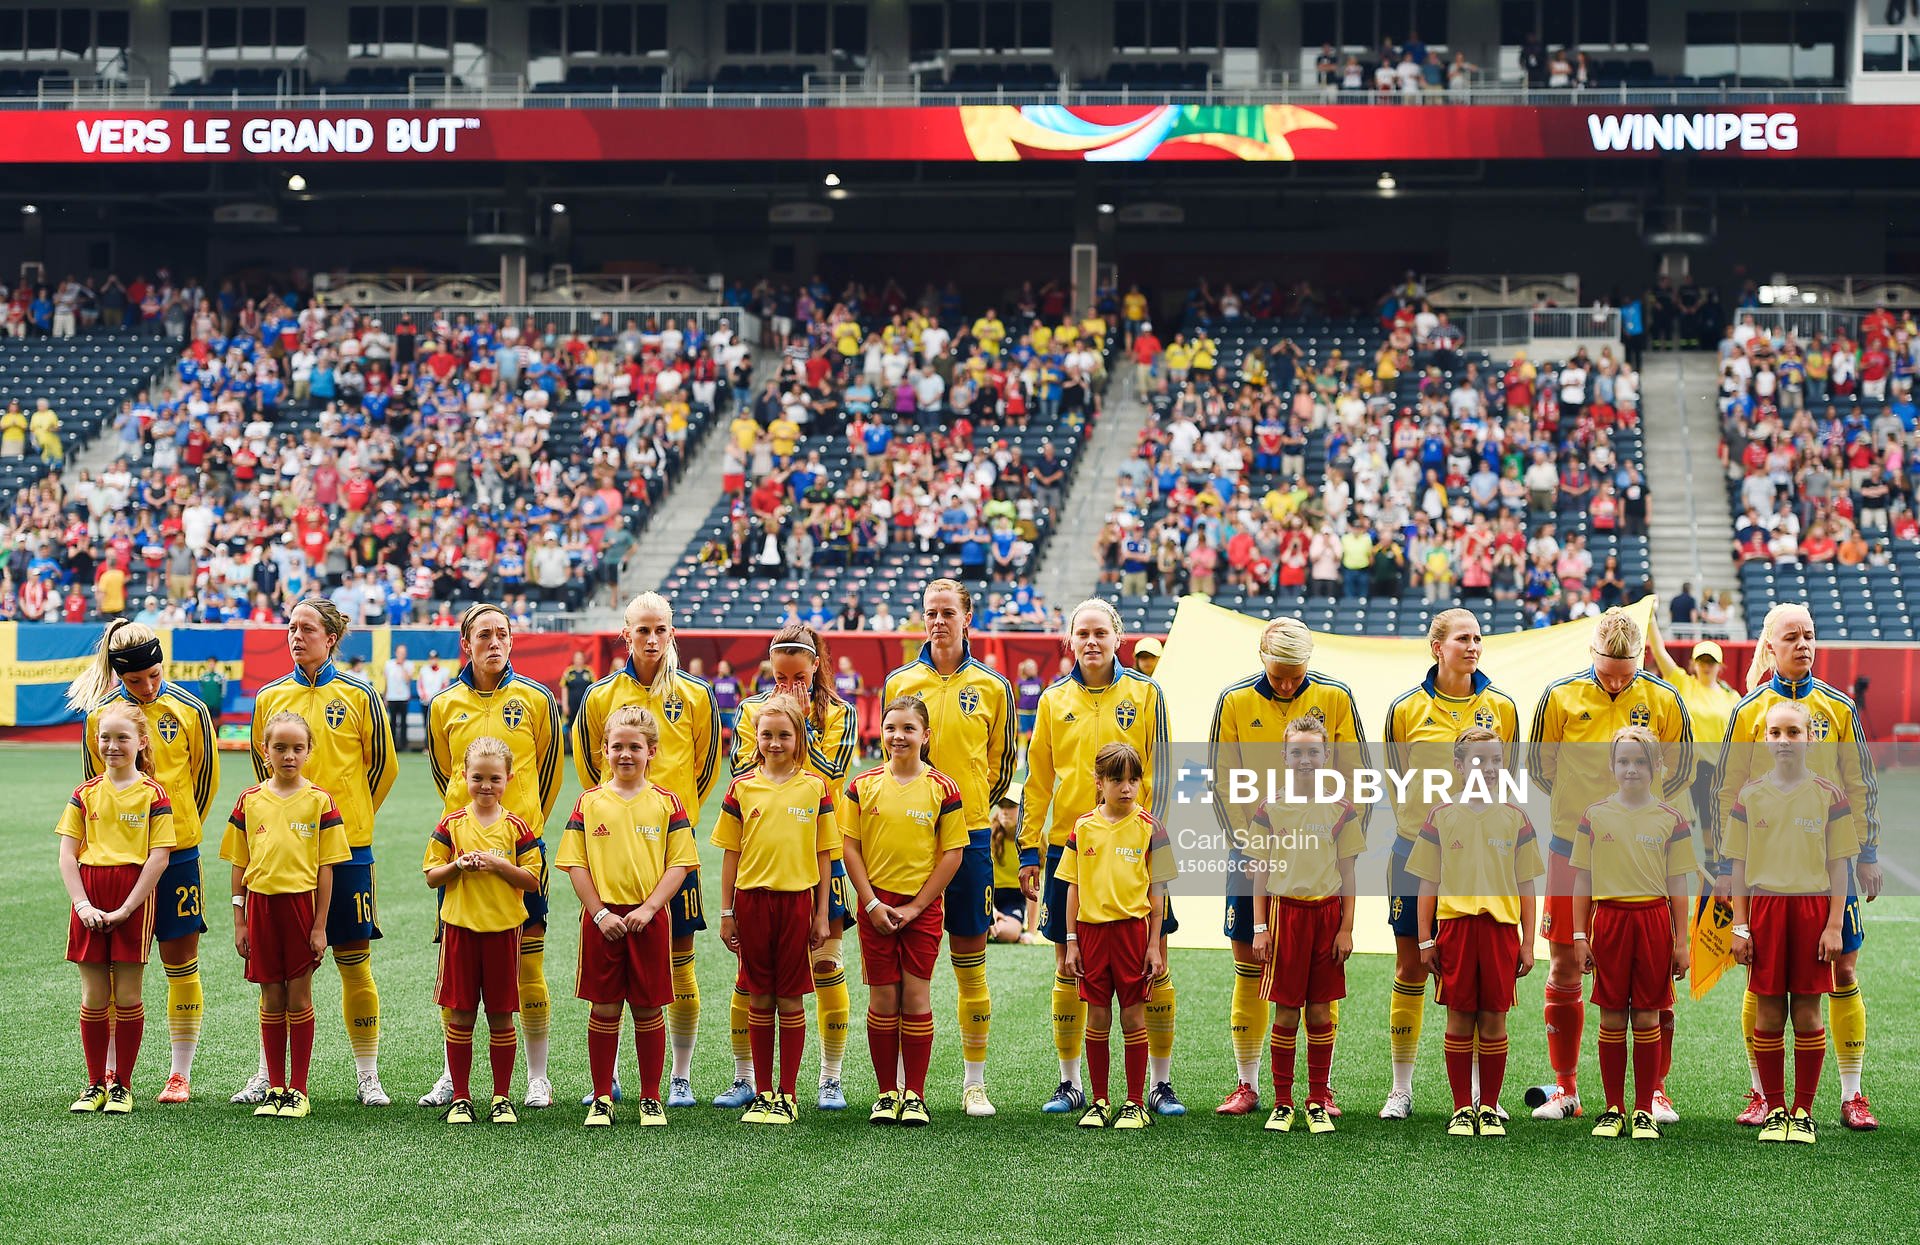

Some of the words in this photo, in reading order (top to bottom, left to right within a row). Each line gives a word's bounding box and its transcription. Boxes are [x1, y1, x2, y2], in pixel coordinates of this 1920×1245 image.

[76, 119, 171, 153] VERS
[183, 119, 231, 153] LE
[242, 118, 374, 153] GRAND
[1588, 113, 1799, 151] WINNIPEG
[787, 807, 807, 816] FIFA
[906, 809, 925, 819] FIFA
[120, 813, 139, 822] FIFA
[290, 822, 308, 831] FIFA
[636, 825, 655, 835] FIFA
[1115, 847, 1134, 857] FIFA
[831, 877, 843, 906] 9
[175, 885, 200, 918] 23
[681, 888, 698, 920] 10
[984, 885, 993, 917] 8
[353, 891, 371, 924] 16
[1146, 1004, 1172, 1013] SVFF
[354, 1016, 378, 1028] SVFF
[1053, 1014, 1077, 1022] SVFF
[1390, 1026, 1413, 1035] SVFF
